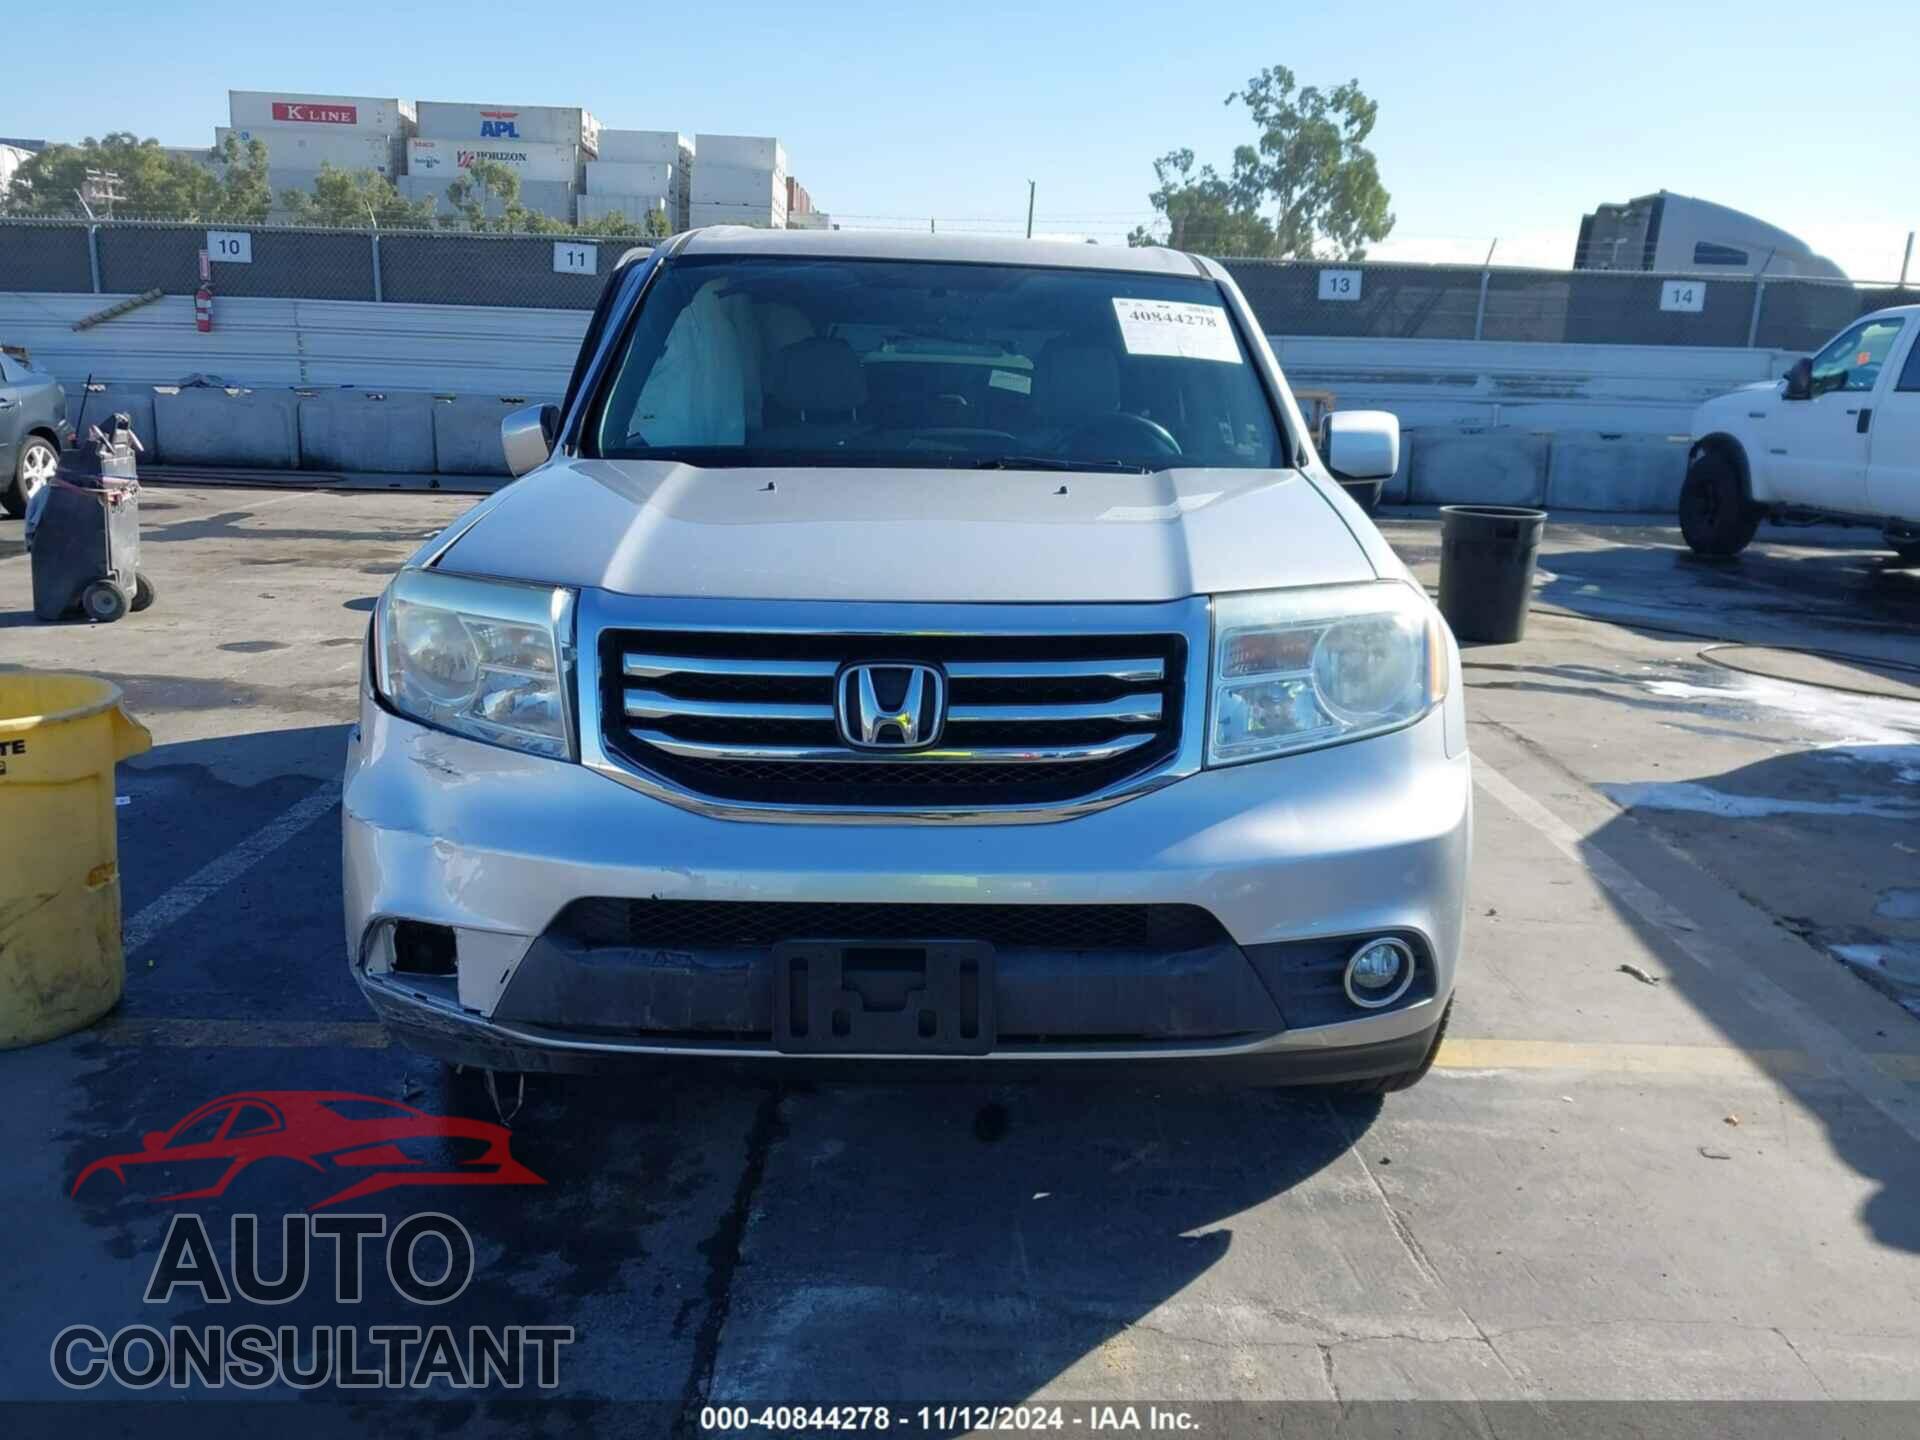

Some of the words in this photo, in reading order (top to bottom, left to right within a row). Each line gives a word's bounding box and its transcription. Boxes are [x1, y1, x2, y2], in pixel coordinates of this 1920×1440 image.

[287, 105, 304, 120] K
[309, 110, 352, 122] LINE
[480, 120, 520, 138] APL
[477, 151, 528, 161] HORIZON
[218, 239, 240, 255] 10
[567, 250, 585, 267] 11
[1330, 277, 1350, 293] 13
[1672, 289, 1693, 304] 14
[1129, 309, 1217, 328] 40844278
